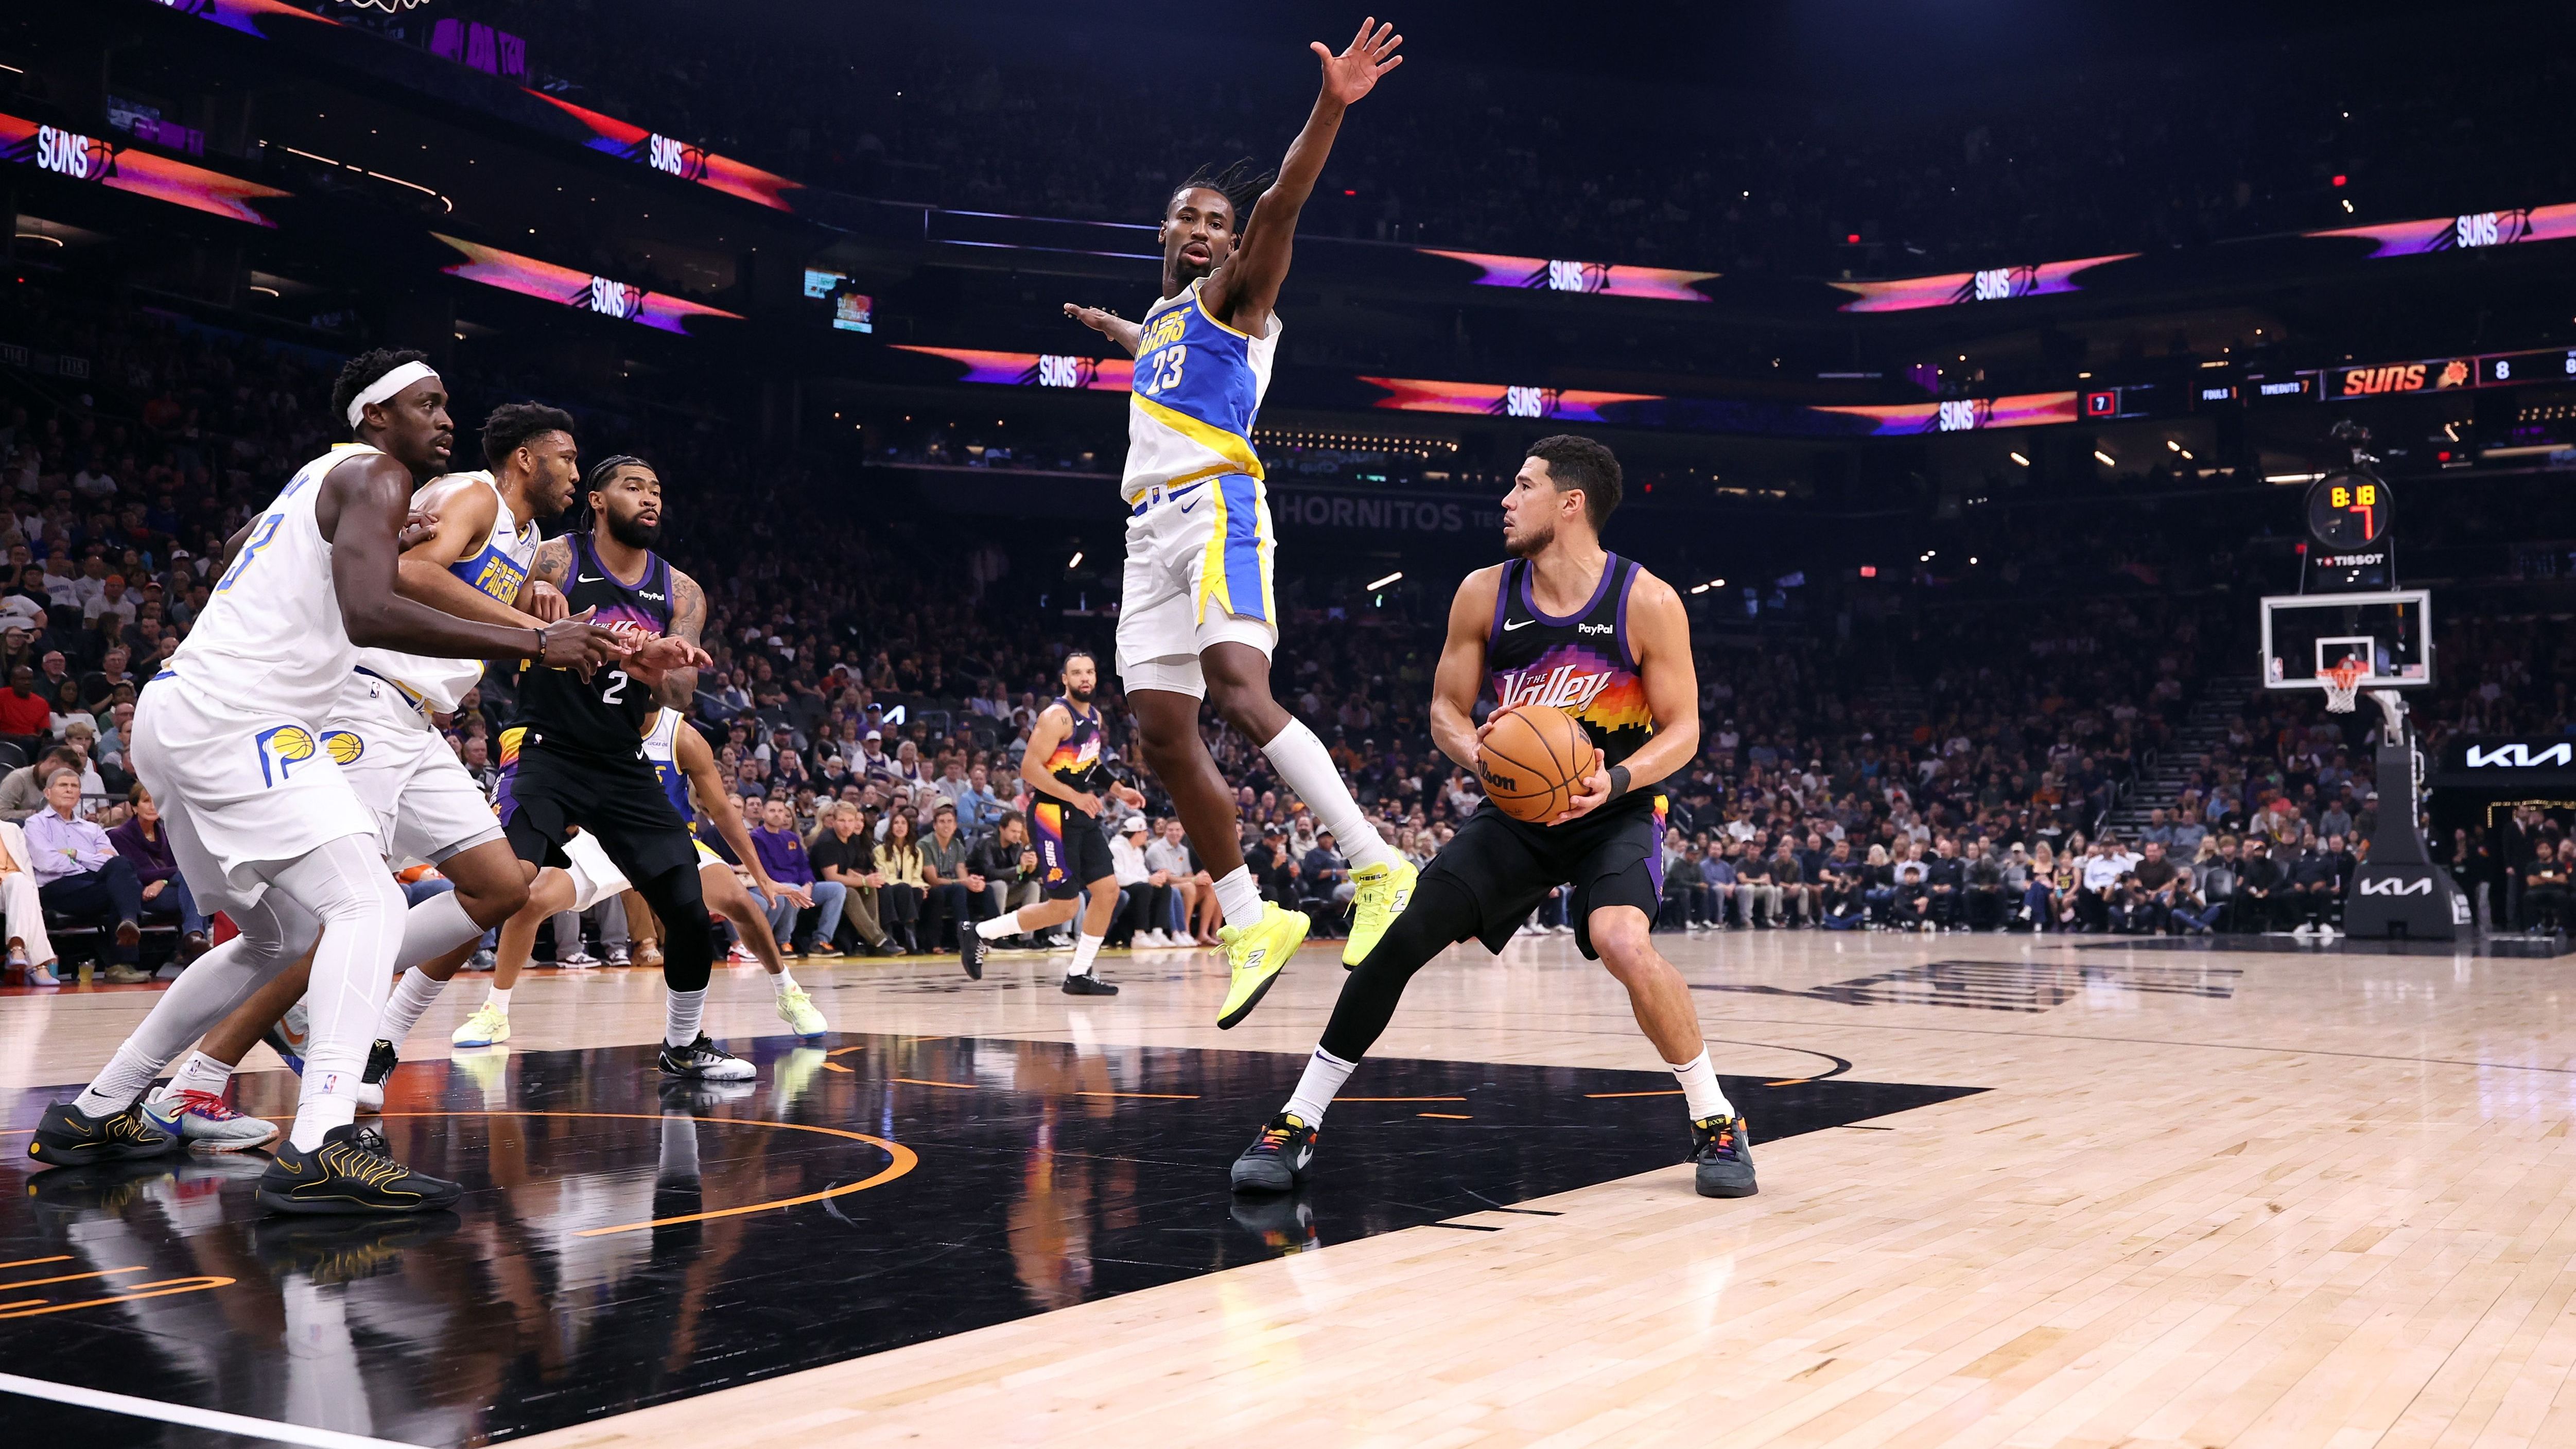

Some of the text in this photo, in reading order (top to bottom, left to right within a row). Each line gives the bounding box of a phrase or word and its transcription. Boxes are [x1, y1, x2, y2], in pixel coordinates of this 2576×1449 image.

[38, 125, 88, 178] SUNS
[650, 133, 682, 175] SUNS
[2457, 212, 2498, 248] SUNS
[1550, 259, 1583, 292] SUNS
[1975, 268, 2009, 301] SUNS
[591, 276, 624, 318] SUNS
[1039, 355, 1077, 388] SUNS
[1146, 344, 1187, 395] 23
[2343, 364, 2427, 396] SUNS
[2496, 361, 2510, 379] 8
[1507, 386, 1542, 418] SUNS
[2097, 397, 2104, 410] 7
[2202, 388, 2229, 400] FOULS
[2260, 382, 2300, 395] TIMEOUTS
[1939, 399, 1974, 431] SUNS
[2331, 484, 2376, 508] 8:18
[1278, 495, 1463, 532] HORNITOS
[2349, 505, 2373, 540] 7
[2334, 553, 2384, 566] TISSOT
[475, 555, 524, 606] PACERS
[639, 590, 665, 601] PayPal
[1578, 623, 1613, 636] PayPal
[602, 670, 628, 705] 2
[1503, 664, 1613, 712] Valley
[1526, 673, 1548, 685] THE
[2466, 743, 2571, 767] KIA
[2360, 878, 2432, 895] KIA
